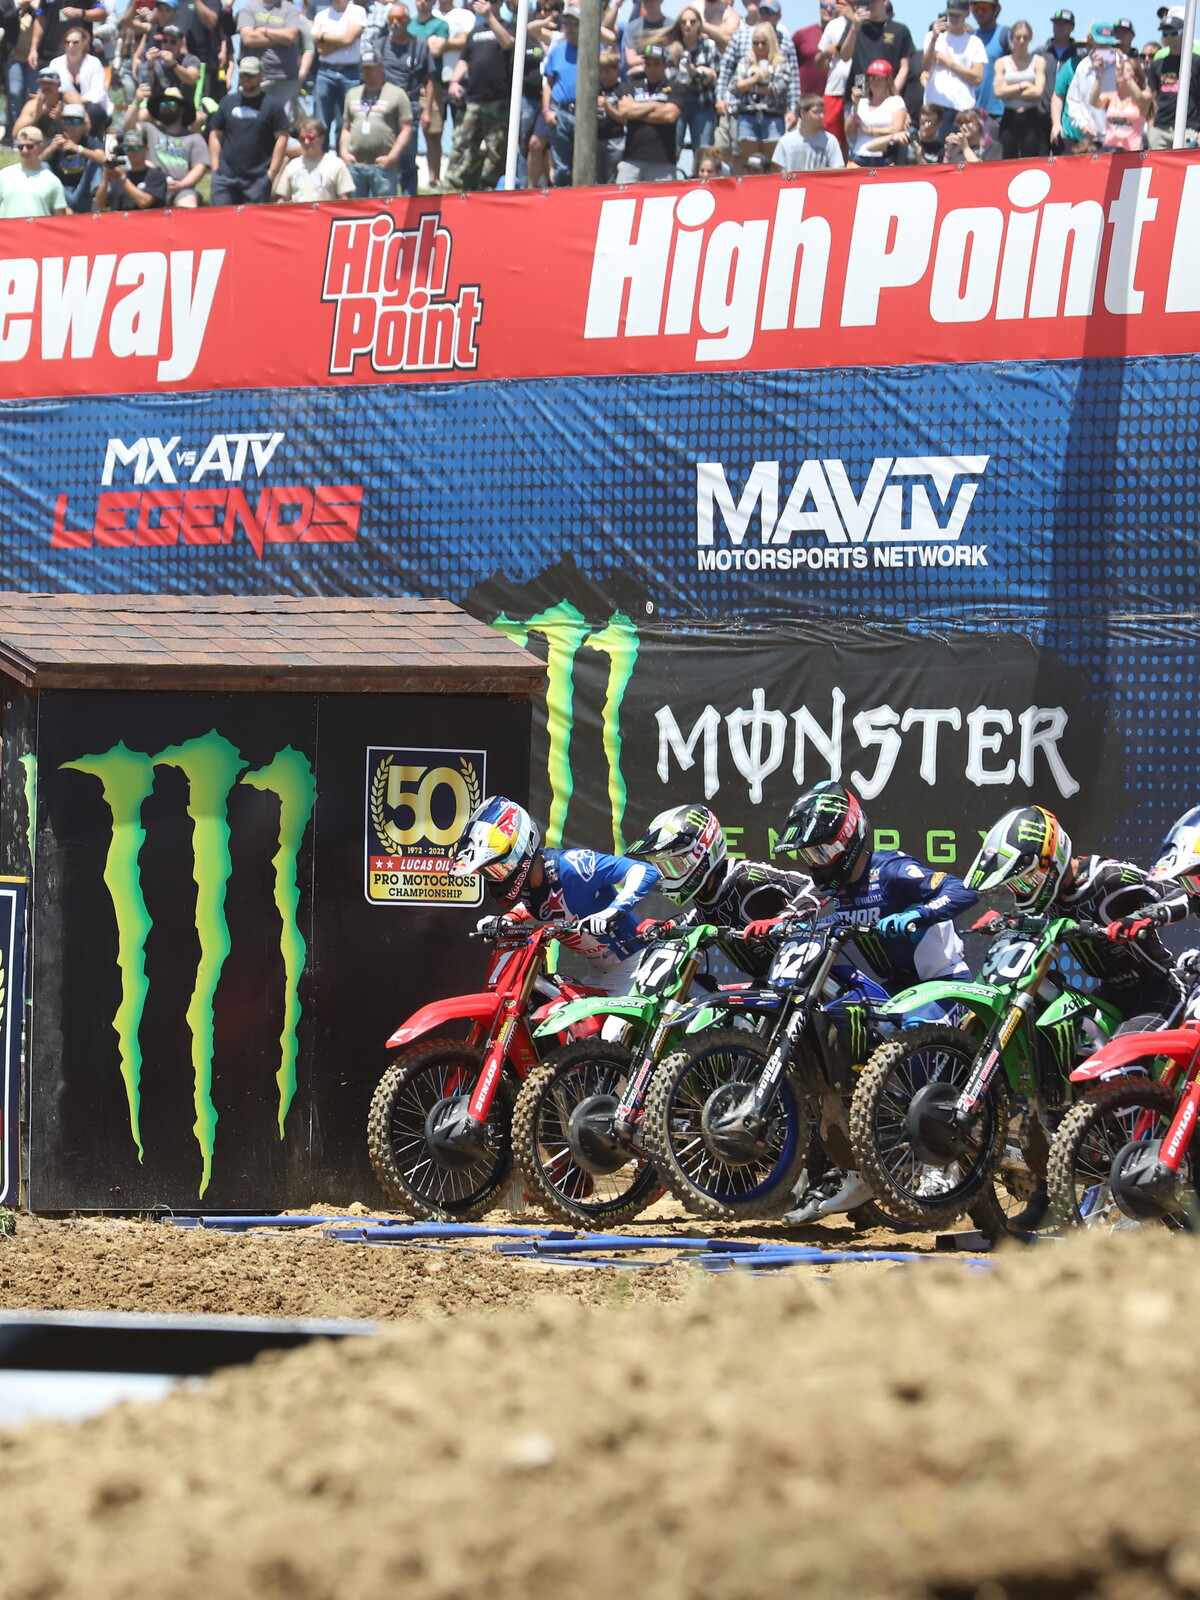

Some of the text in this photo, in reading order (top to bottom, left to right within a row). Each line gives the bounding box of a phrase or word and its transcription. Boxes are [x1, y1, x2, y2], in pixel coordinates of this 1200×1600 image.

[321, 212, 452, 306] High
[584, 187, 832, 361] High
[840, 166, 1159, 327] Point
[328, 285, 483, 375] Point
[101, 436, 181, 486] MX
[190, 432, 285, 483] ATV
[50, 485, 364, 561] LEGENDS
[697, 455, 990, 545] MAVTV
[698, 545, 989, 571] MOTORSPORTS NETWORK
[654, 686, 1081, 805] MONSTER
[383, 765, 471, 846] 50
[400, 858, 433, 871] LUCAS
[407, 847, 424, 855] 1972
[429, 847, 445, 855] 2022
[374, 874, 476, 887] PRO MOTOCROSS
[388, 888, 463, 898] CHAMPIONSHIP
[488, 951, 515, 985] 1
[768, 943, 822, 979] 32
[474, 1059, 497, 1112] DUNLOP
[1167, 1100, 1196, 1158] DUNLOP
